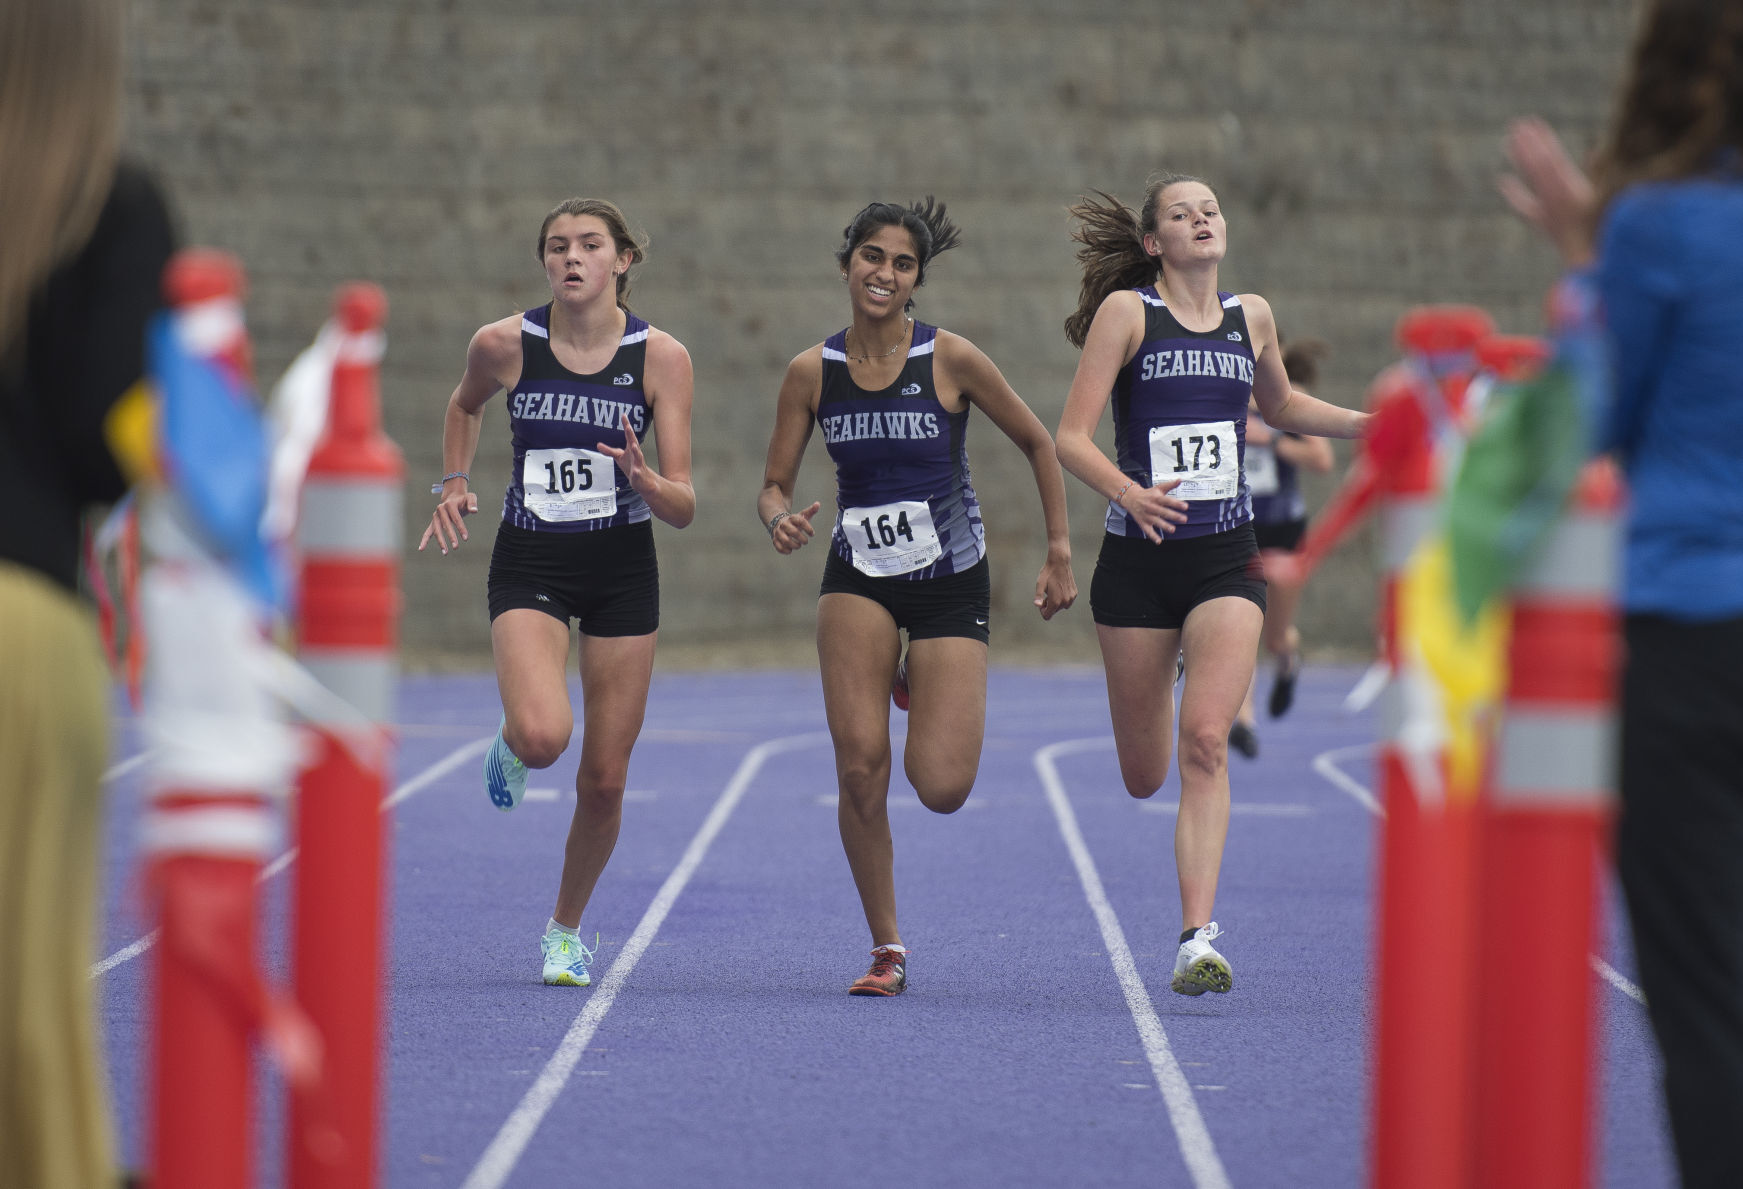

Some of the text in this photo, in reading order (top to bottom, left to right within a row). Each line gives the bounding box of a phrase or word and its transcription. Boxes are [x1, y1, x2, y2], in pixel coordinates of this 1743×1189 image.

[1141, 350, 1254, 386] SEAHAWKS
[512, 393, 645, 432] SEAHAWKS
[823, 411, 940, 443] SEAHAWKS
[1171, 434, 1222, 472] 173
[544, 458, 593, 494] 165
[861, 511, 914, 550] 164
